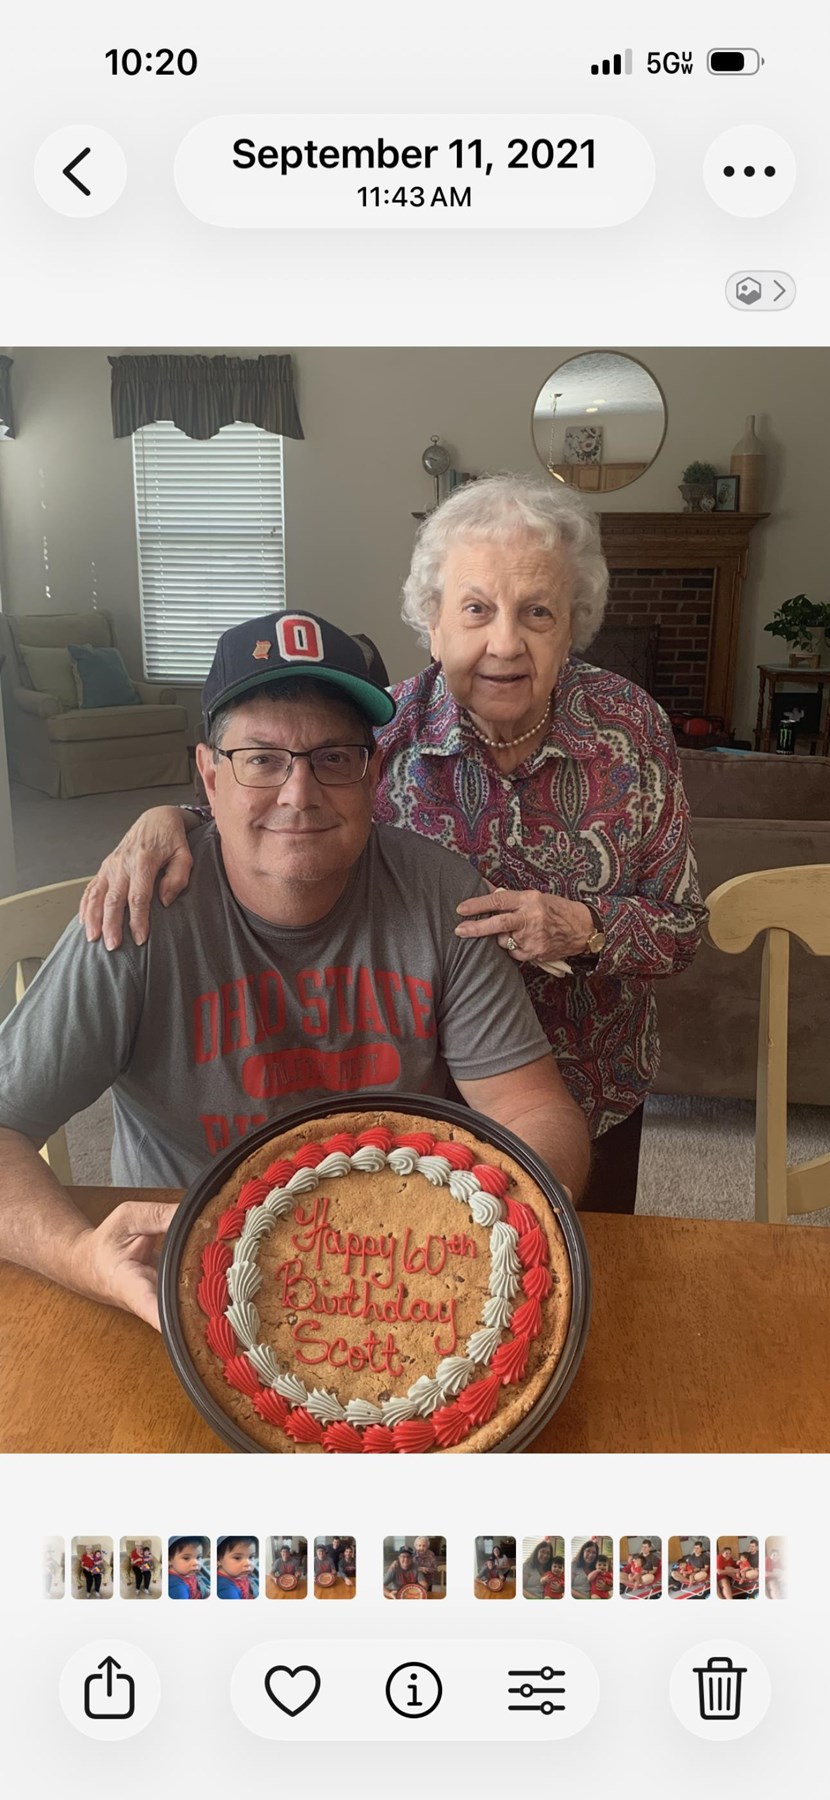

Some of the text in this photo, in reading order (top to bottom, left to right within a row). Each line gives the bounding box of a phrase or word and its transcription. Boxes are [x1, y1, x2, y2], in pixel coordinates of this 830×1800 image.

[275, 614, 324, 662] O
[295, 965, 435, 1040] STATE
[291, 1197, 477, 1289] Happy 60th
[275, 1258, 457, 1355] Birthday
[293, 1319, 404, 1377] Scott
